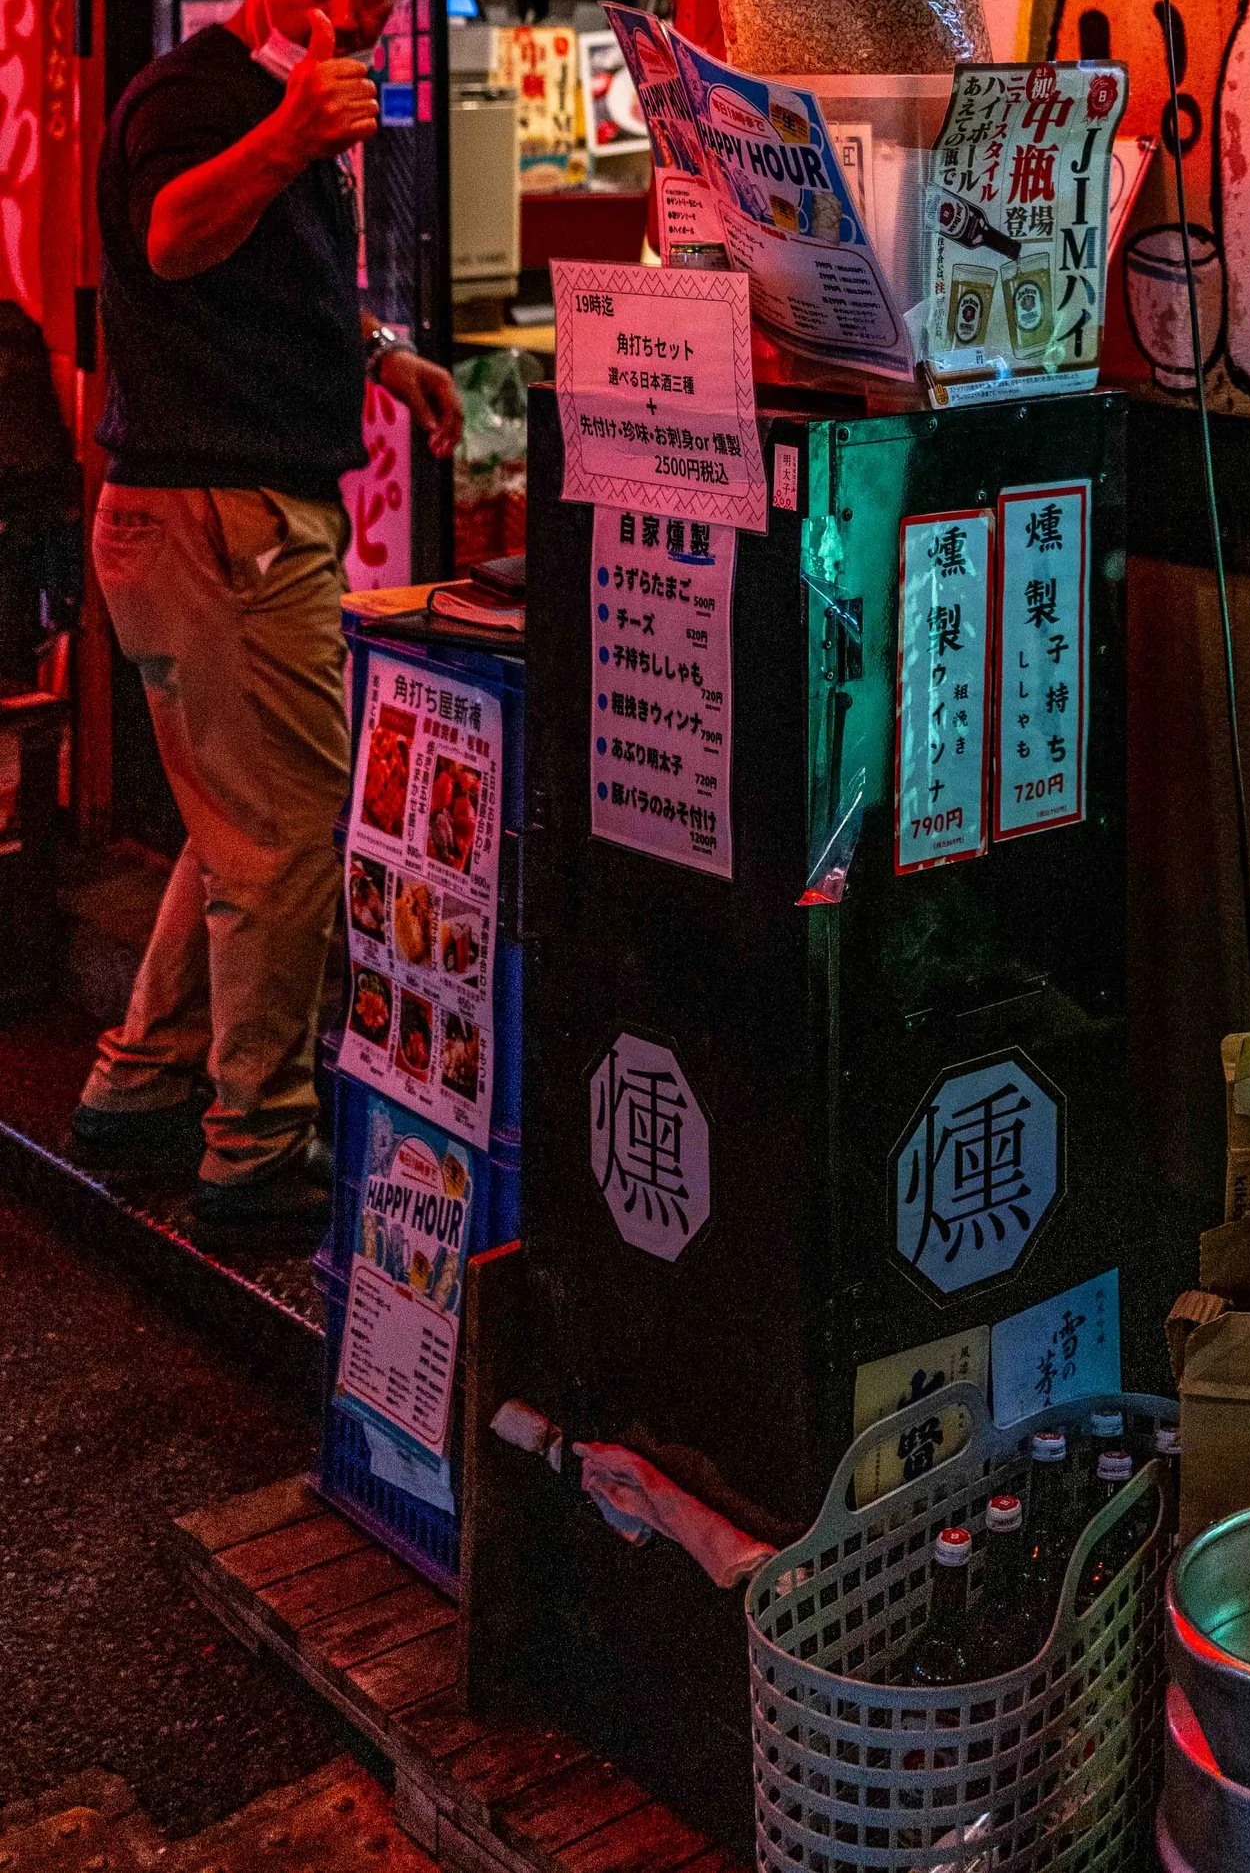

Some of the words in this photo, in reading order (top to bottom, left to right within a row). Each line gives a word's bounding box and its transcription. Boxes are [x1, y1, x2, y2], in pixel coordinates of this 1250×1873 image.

[701, 121, 745, 169] HAPPY
[745, 140, 831, 190] HOUR
[940, 76, 982, 185] あえての瓶で
[958, 75, 1005, 194] ハイボール
[980, 77, 1026, 203] ニュースタイル
[1006, 89, 1074, 205] 中瓶
[1003, 204, 1055, 237] 登場
[1056, 127, 1102, 358] JIMハイ
[575, 294, 614, 317] 19時迄
[617, 332, 694, 361] 角打ちセット
[608, 367, 695, 395] 選べる日本酒三種
[357, 378, 401, 590] ハッピ
[654, 455, 729, 485] 2500円税込
[620, 512, 711, 557] 自家燻製
[1024, 503, 1064, 629] 燻製
[613, 566, 692, 602] うずらたまご
[693, 596, 715, 612] 500円
[928, 526, 967, 656] 燻製
[616, 608, 655, 635] チーズ
[686, 628, 708, 644] 620円
[613, 644, 703, 687] 子持ちししゃも
[701, 688, 723, 705] 720円
[1017, 650, 1031, 759] ししゃも
[1045, 634, 1069, 764] 子持ち
[612, 737, 683, 777] あぶり明太子
[695, 773, 717, 790] 720円
[700, 729, 722, 746] 790円
[612, 781, 716, 834] 豚バラのみそ付け
[1013, 772, 1064, 804] 720円
[910, 807, 964, 840] 790円
[596, 1049, 691, 1236] 燻
[904, 1082, 1032, 1267] 燻
[366, 1179, 412, 1223] HAPPY
[411, 1191, 463, 1249] HOUR
